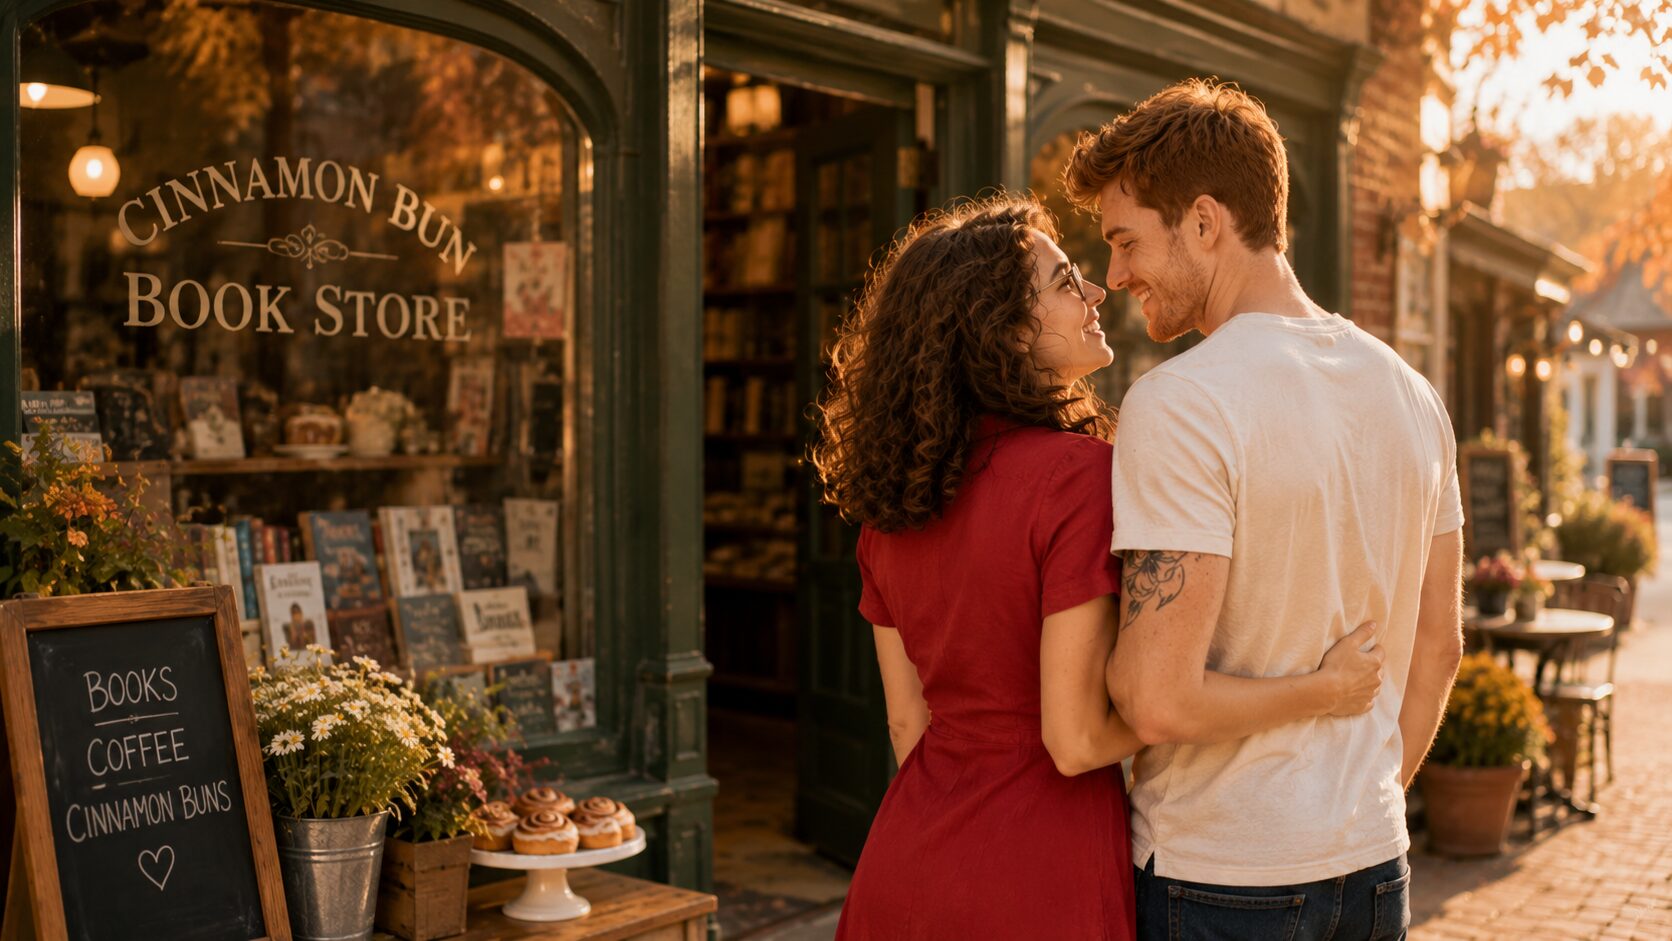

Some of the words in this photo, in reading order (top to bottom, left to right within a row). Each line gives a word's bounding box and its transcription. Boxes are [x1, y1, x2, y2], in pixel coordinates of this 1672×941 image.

[118, 156, 379, 246] CINNAMON
[388, 184, 477, 276] BUN
[123, 272, 294, 334] BOOK
[314, 284, 472, 342] STORE
[83, 666, 178, 712] BOOKS
[87, 728, 190, 776] COFFEE
[66, 790, 175, 843] CINNAMON
[179, 780, 232, 820] BUNS
